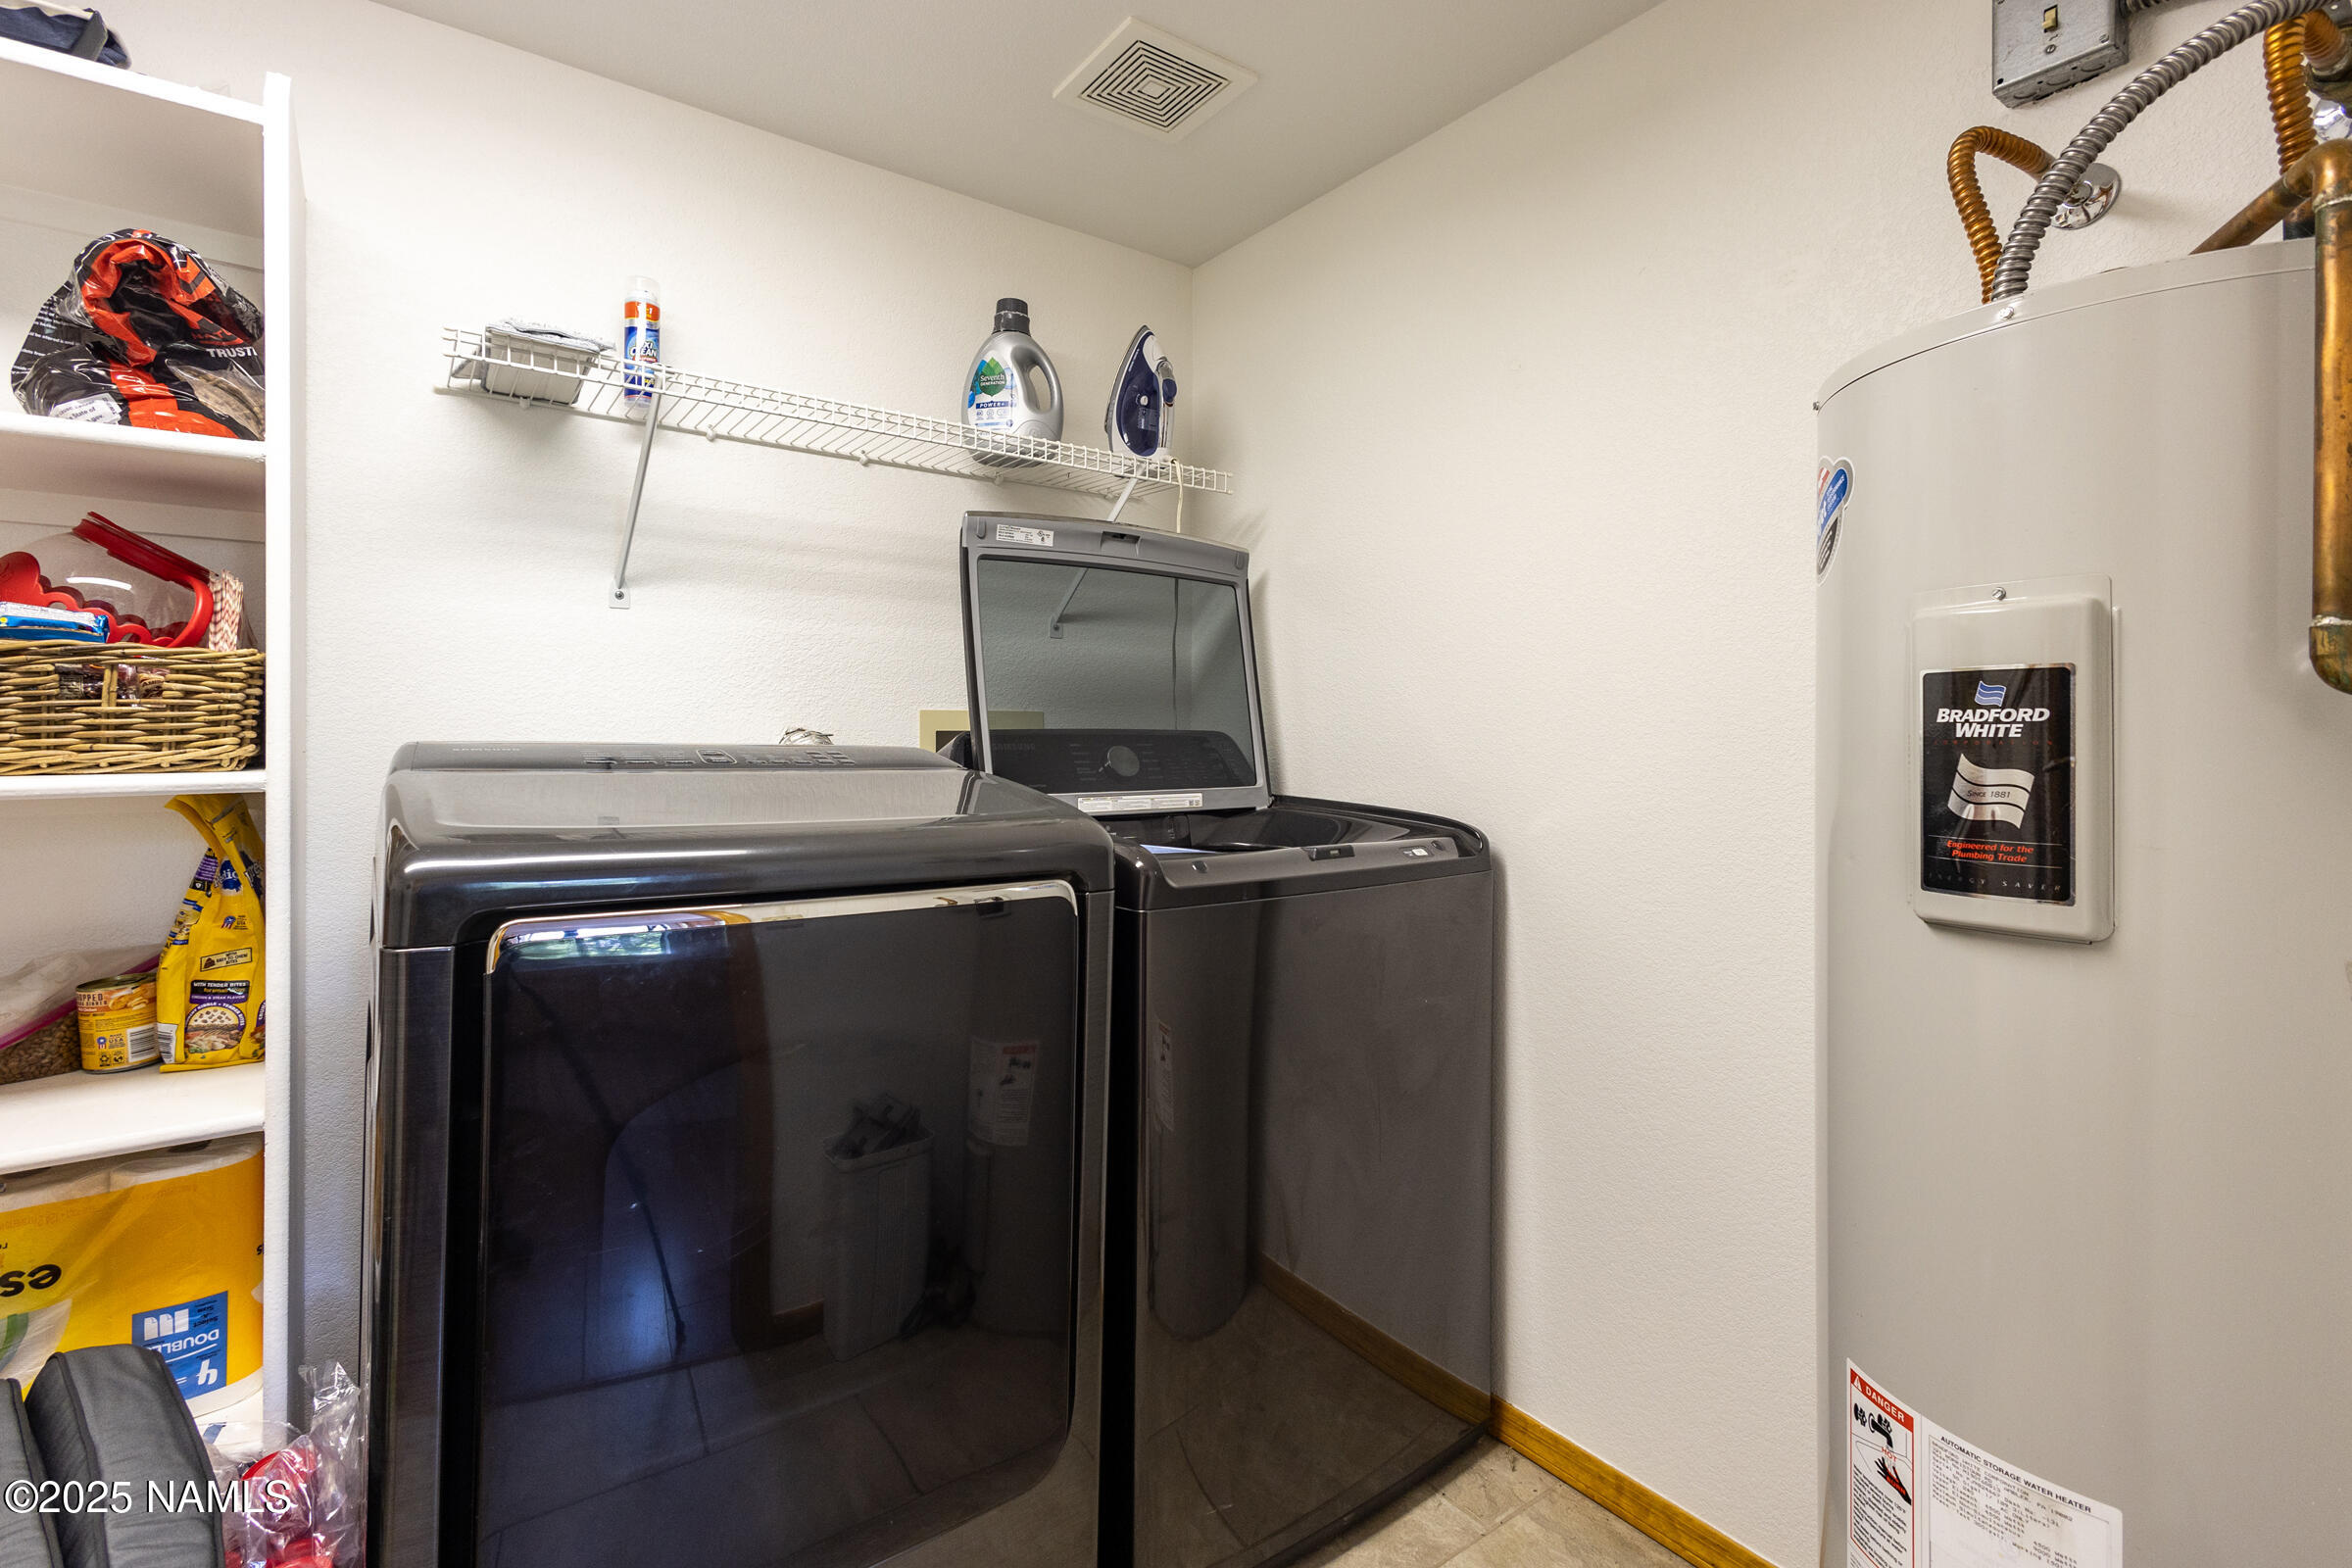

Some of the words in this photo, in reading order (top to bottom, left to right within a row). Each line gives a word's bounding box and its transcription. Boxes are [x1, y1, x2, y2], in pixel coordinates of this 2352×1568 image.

[629, 347, 657, 358] CEAN
[1936, 708, 2050, 723] BRADFORD
[1956, 723, 2024, 737] WHITE
[1946, 840, 1997, 852] Engineered
[1999, 844, 2014, 853] for
[2017, 845, 2034, 854] the
[1952, 850, 1994, 861] Plumbing
[1997, 854, 2027, 863] Trade
[2002, 880, 2061, 891] SAVER
[196, 1358, 218, 1385] 4
[1865, 1385, 1905, 1423] DANGER
[1881, 1446, 1897, 1462] HOT
[1940, 1435, 1981, 1463] AUTOMATIC
[1983, 1458, 2021, 1483] STORAGE
[2023, 1478, 2052, 1497] WATER
[2055, 1493, 2090, 1513] HEATER
